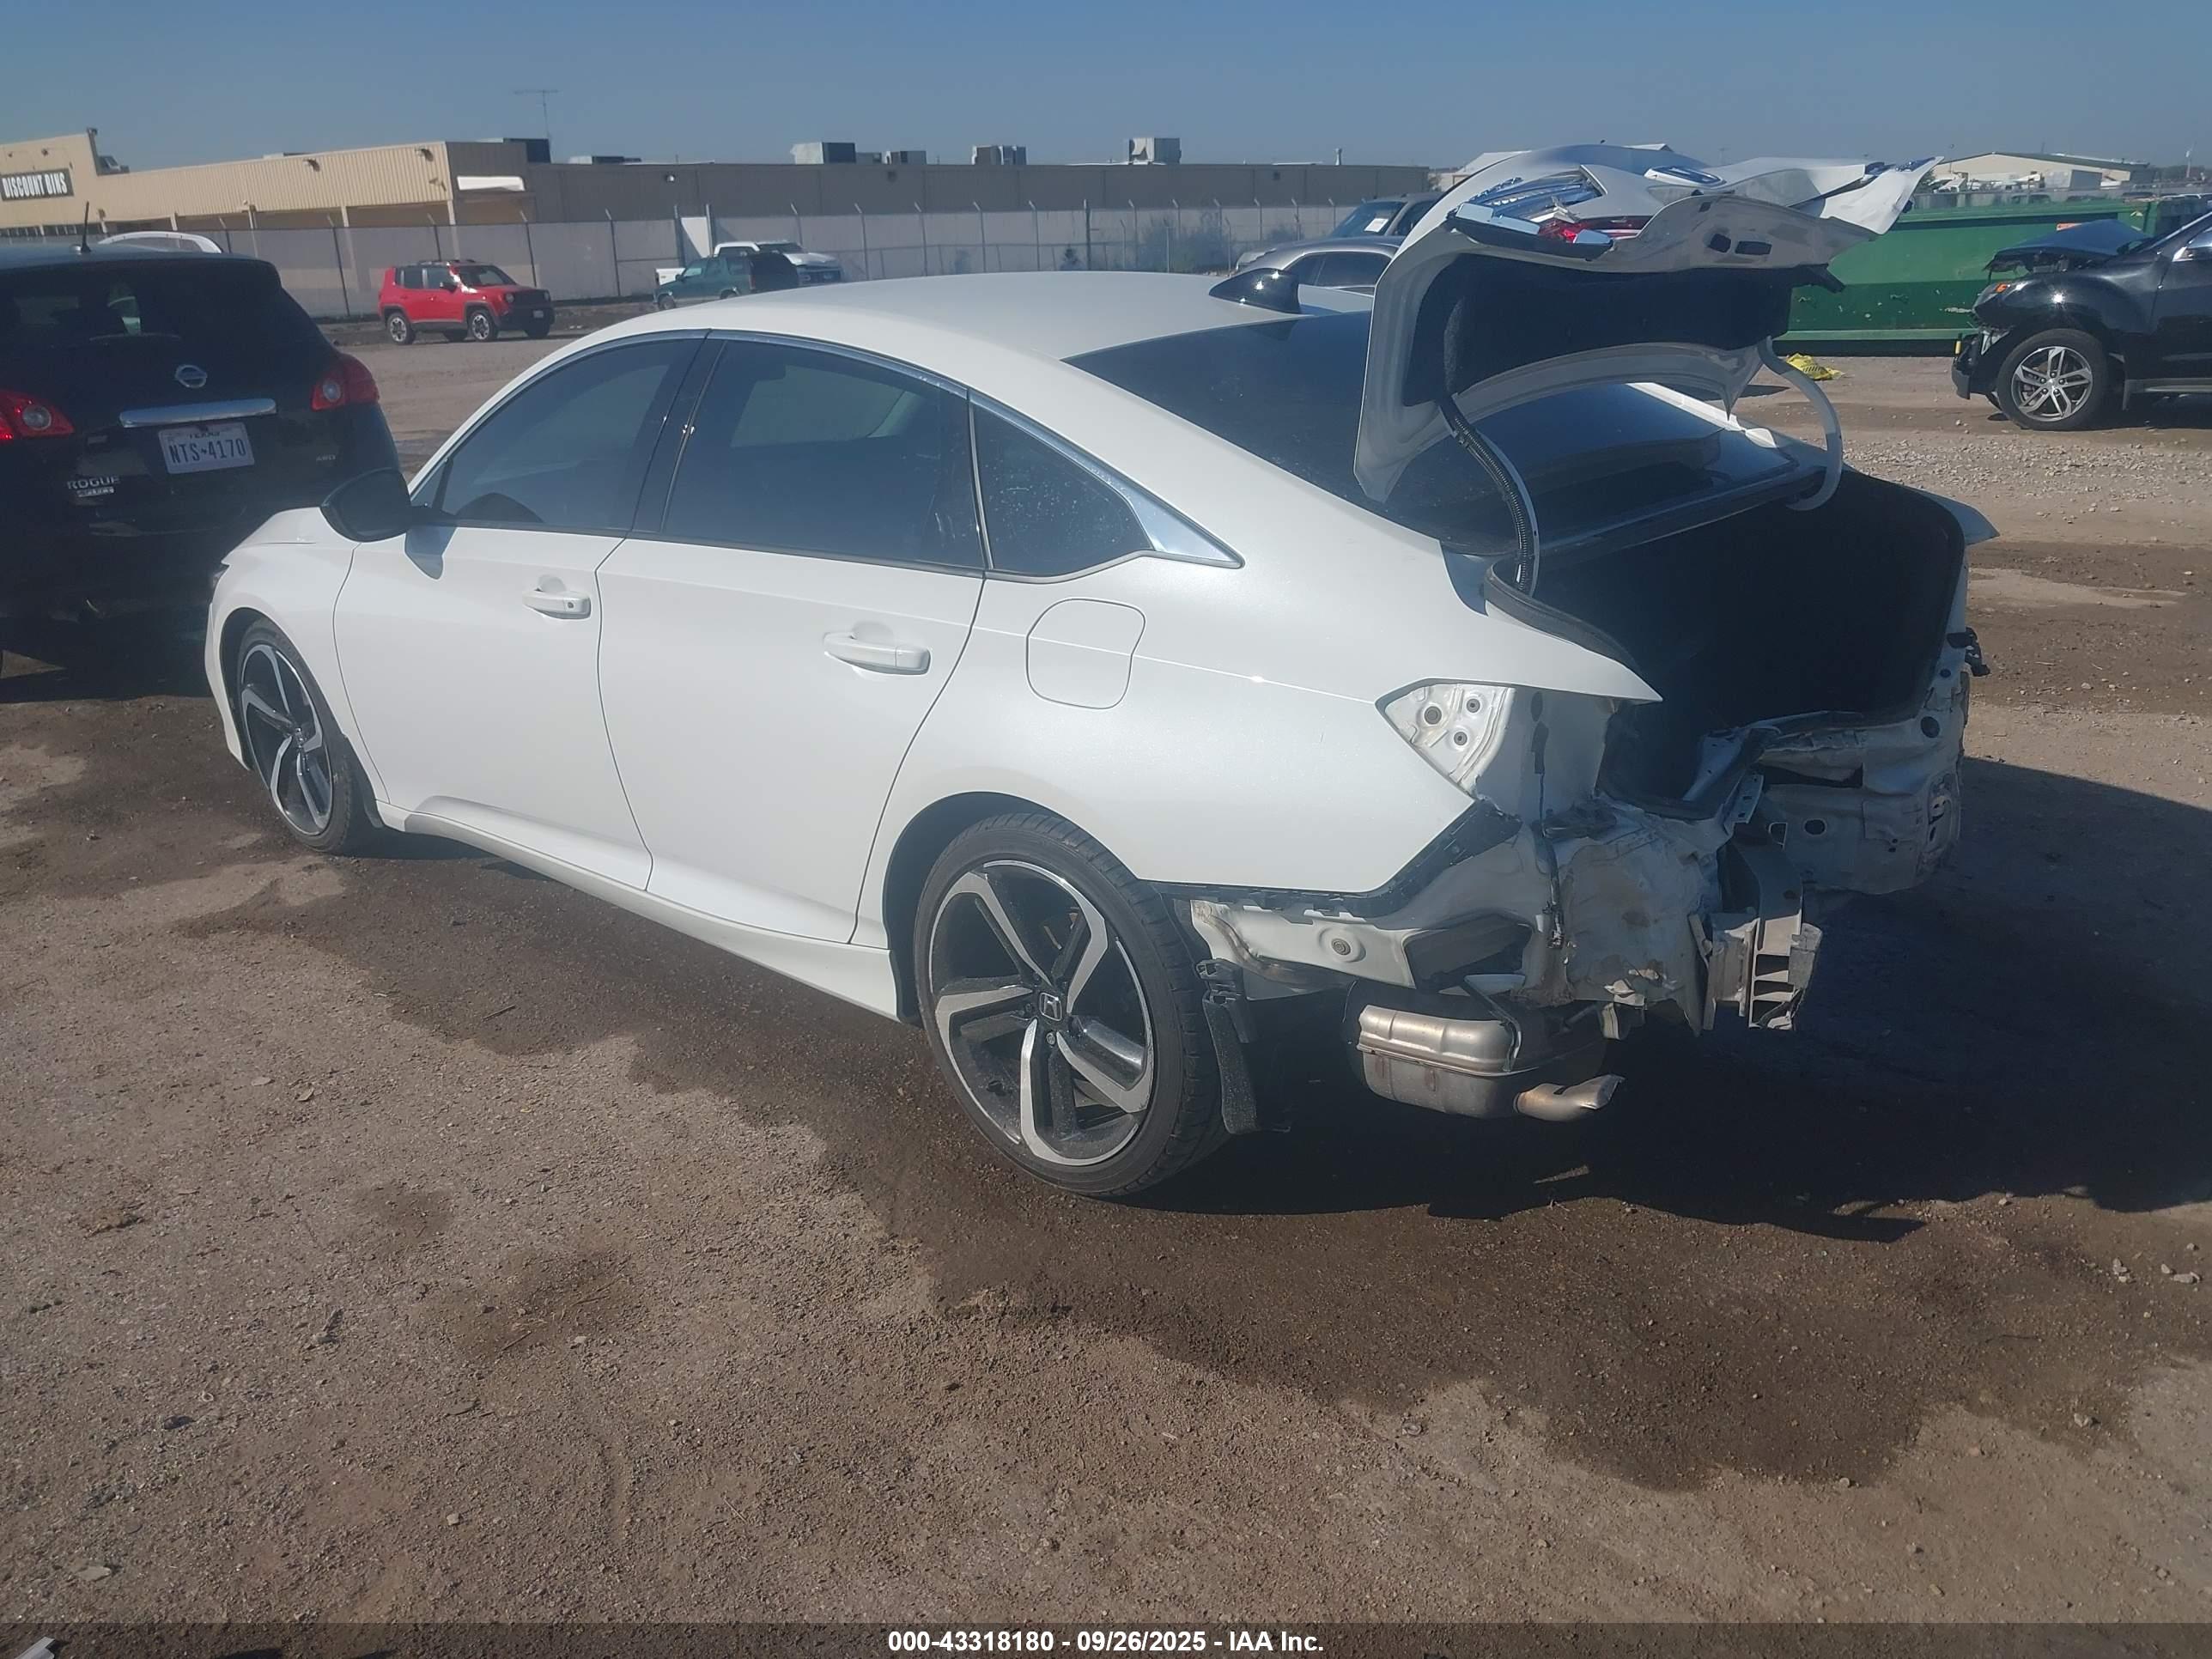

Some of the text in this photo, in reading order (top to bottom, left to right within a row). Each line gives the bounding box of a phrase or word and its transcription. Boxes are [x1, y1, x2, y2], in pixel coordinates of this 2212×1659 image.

[2, 172, 68, 198] DISCOUNT BINS
[67, 476, 120, 489] ROGUE
